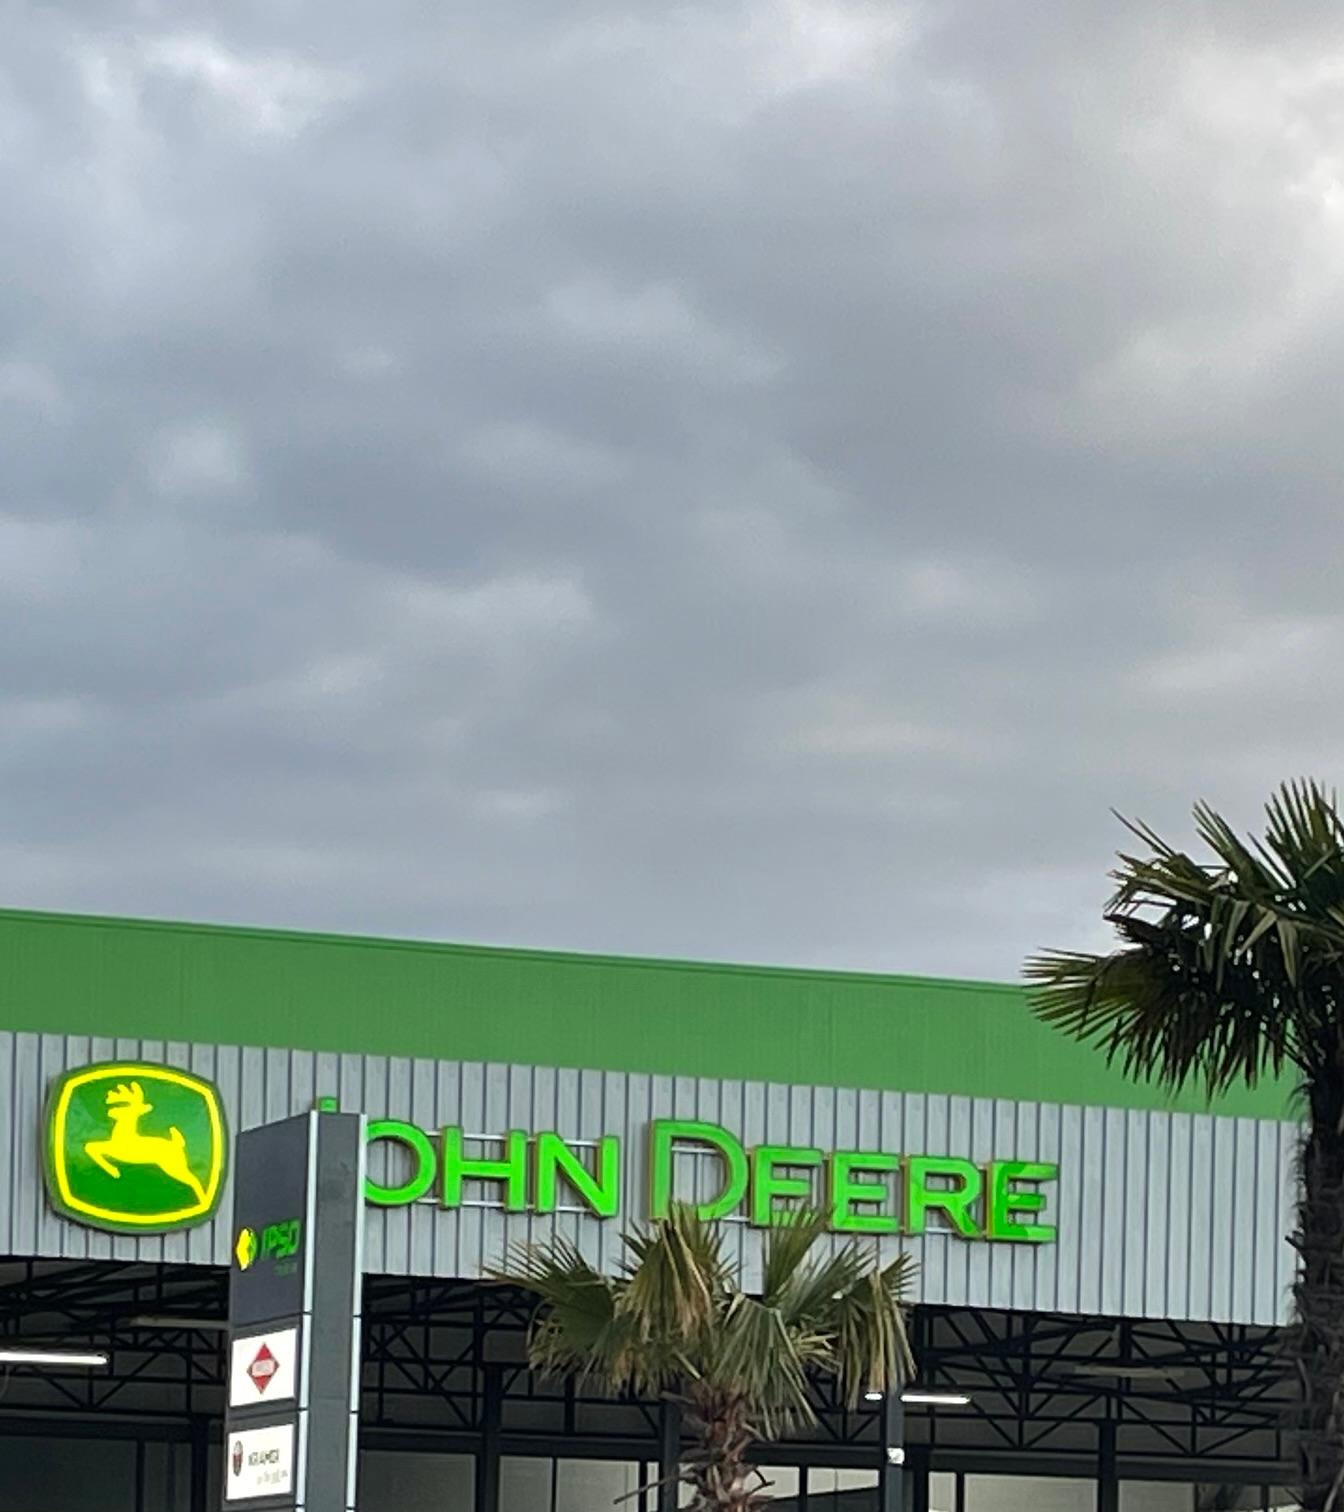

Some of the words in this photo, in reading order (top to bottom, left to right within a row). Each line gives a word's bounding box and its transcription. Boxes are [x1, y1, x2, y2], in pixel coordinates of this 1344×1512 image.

[317, 1096, 621, 1219] OHN
[650, 1119, 1057, 1242] DEERE
[260, 1218, 302, 1260] IPSO
